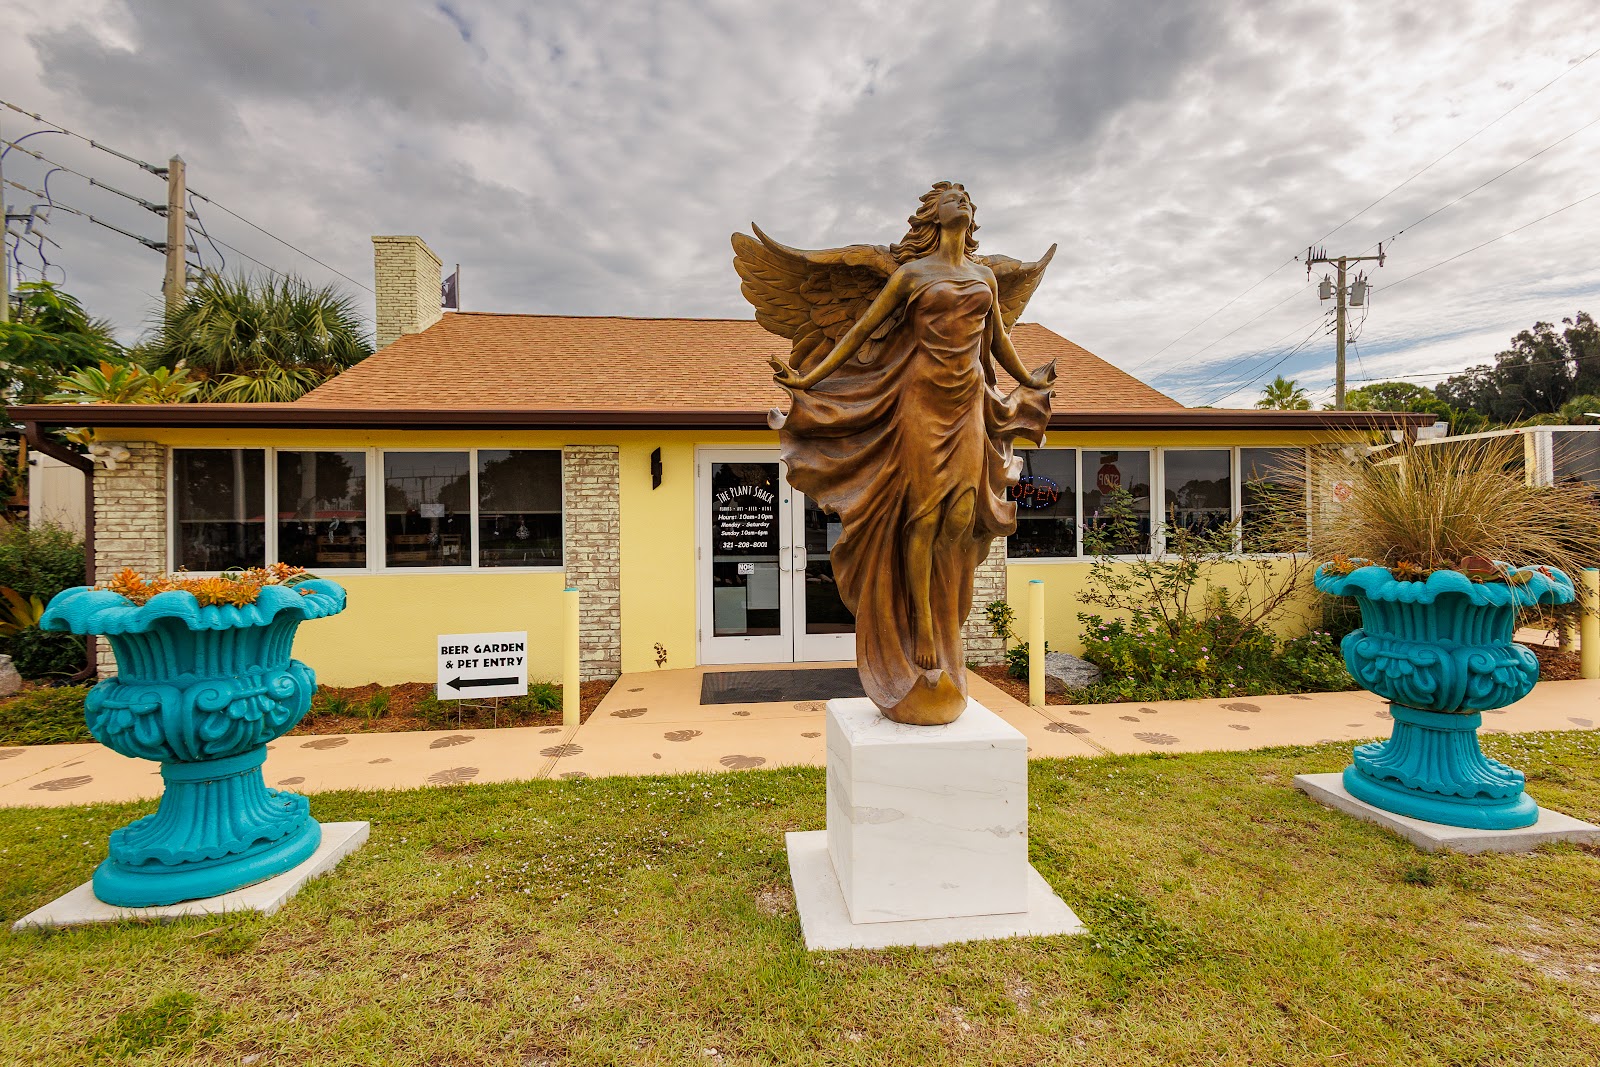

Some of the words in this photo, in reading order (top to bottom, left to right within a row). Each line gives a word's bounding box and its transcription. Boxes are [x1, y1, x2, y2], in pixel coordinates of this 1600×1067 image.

[716, 490, 730, 504] THE
[729, 486, 752, 498] PLANT
[753, 486, 774, 504] SHACK
[1012, 483, 1058, 502] OPEN
[441, 645, 469, 655] BEER
[473, 642, 524, 654] GARDEN
[445, 660, 454, 669] &
[457, 658, 479, 669] PET
[483, 656, 523, 667] ENTRY
